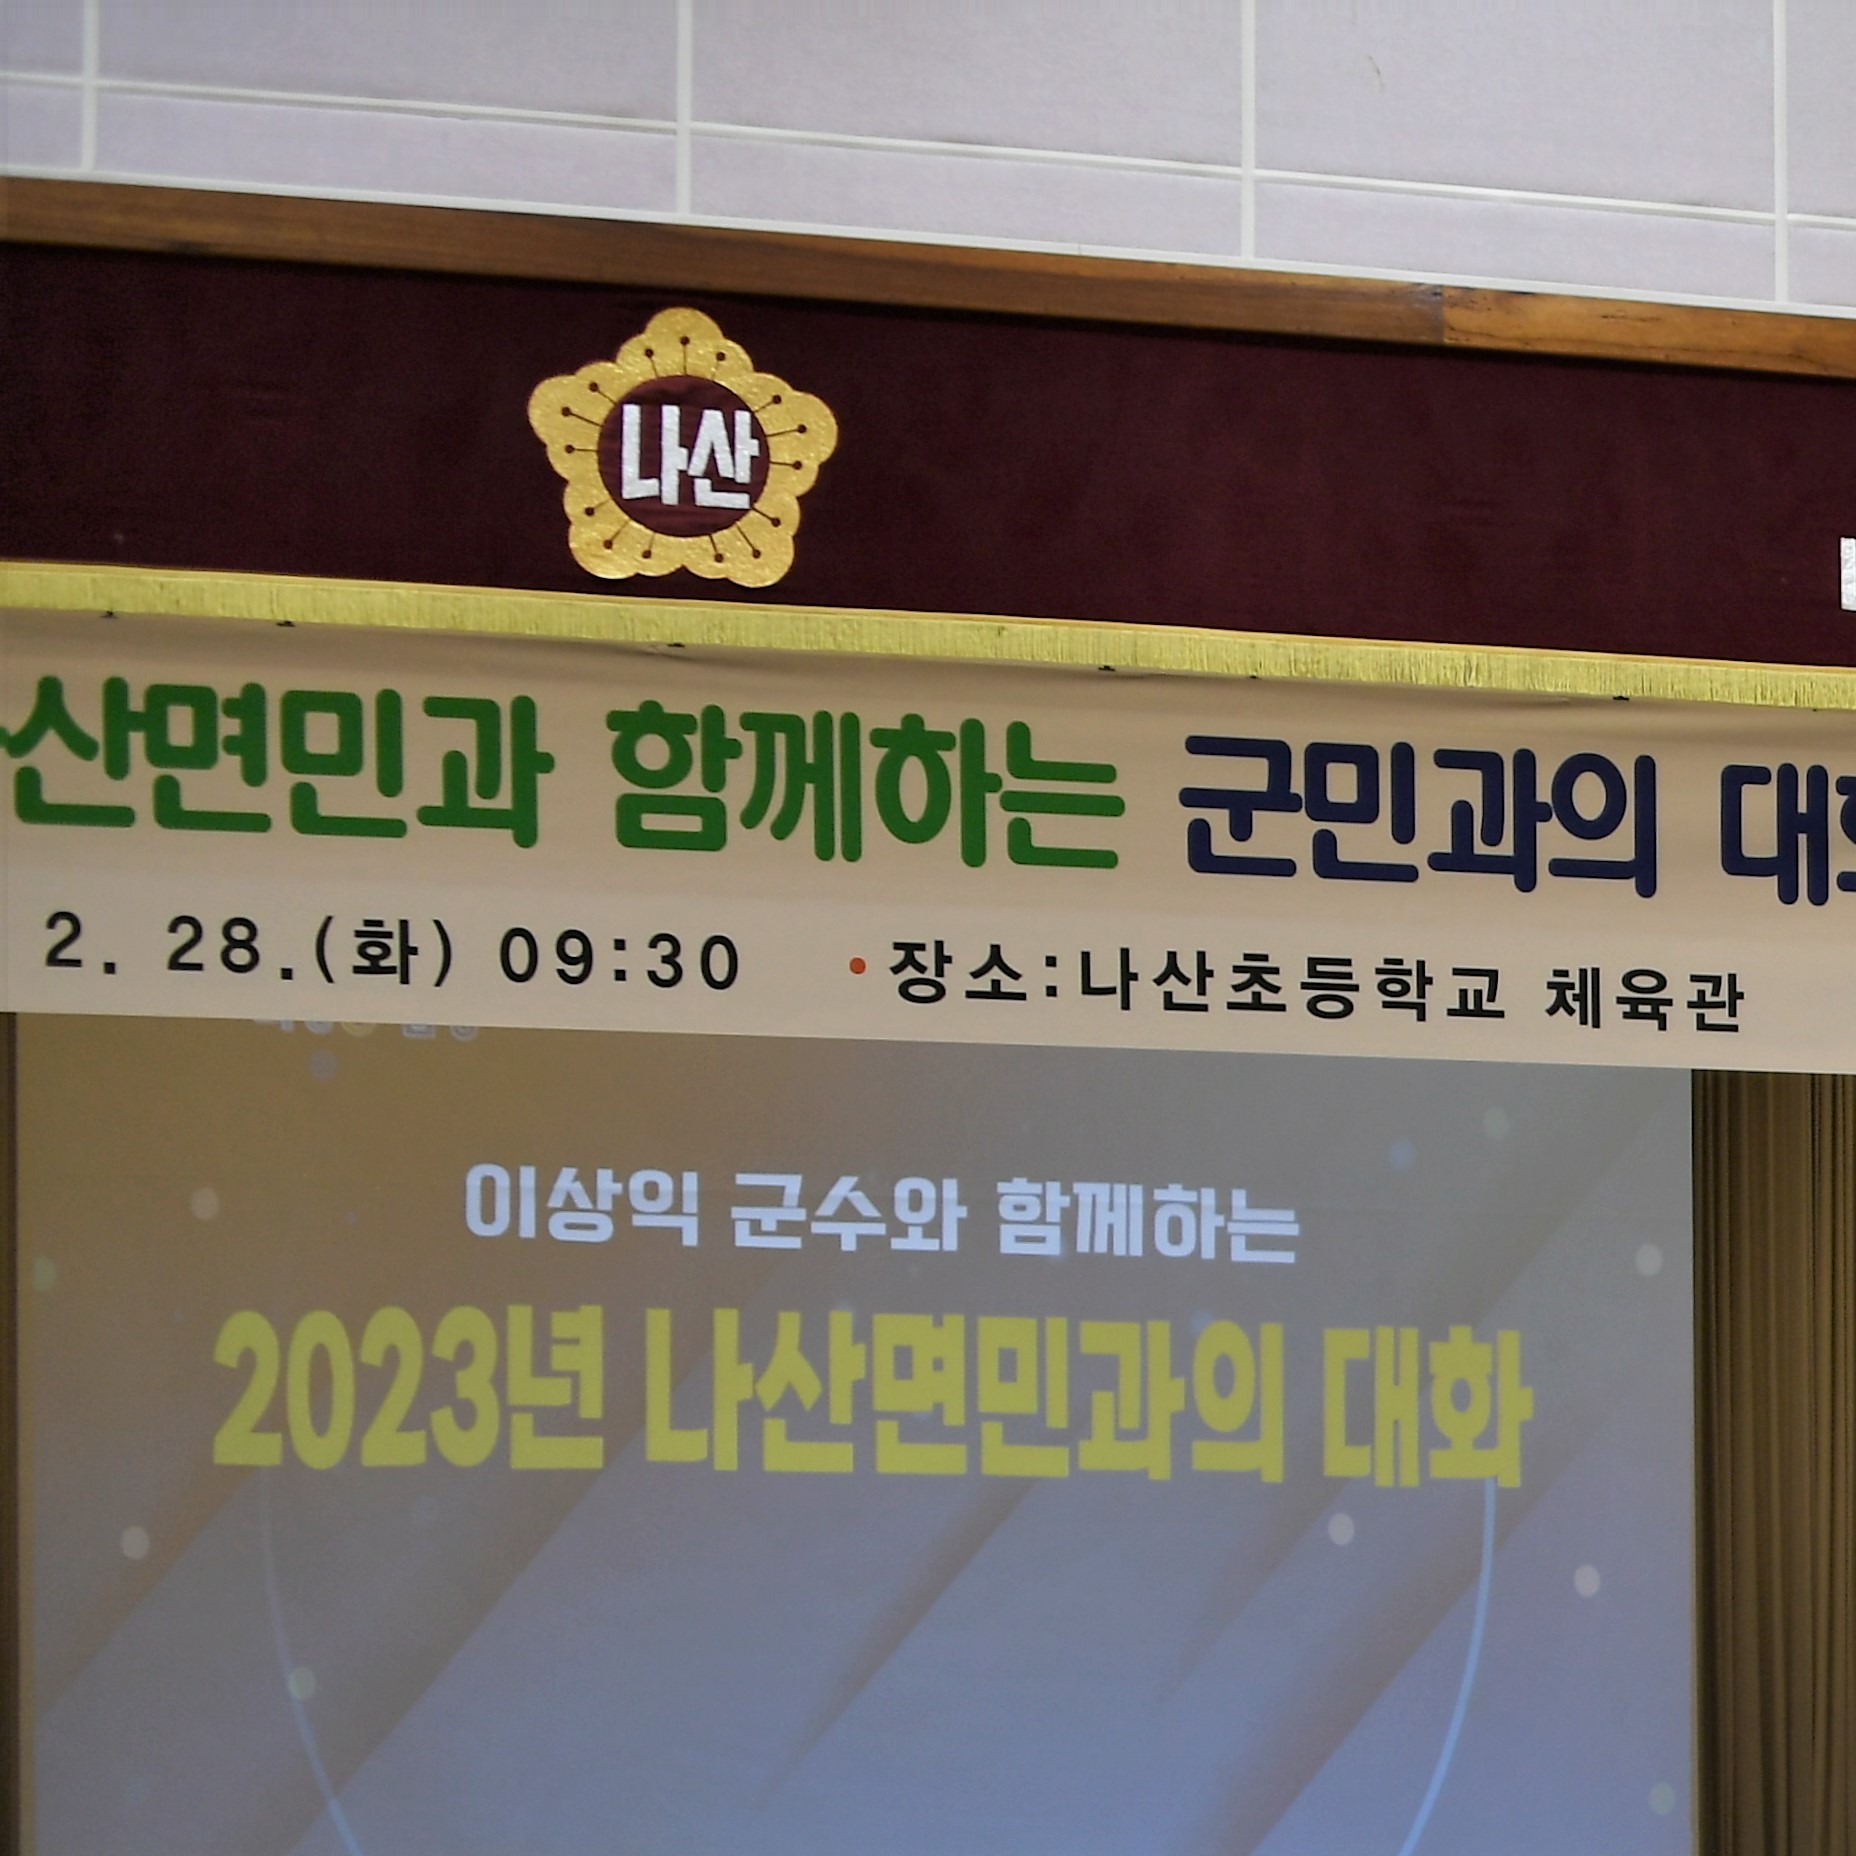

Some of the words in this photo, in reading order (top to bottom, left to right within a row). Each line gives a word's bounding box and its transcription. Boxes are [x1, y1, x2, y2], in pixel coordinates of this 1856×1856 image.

[621, 404, 759, 509] 나산
[4, 677, 554, 848] 산면민과
[606, 701, 1126, 869] 함께하는
[1178, 735, 1657, 899] 군민과의
[499, 927, 739, 991] 09:30
[1545, 966, 1745, 1033] 체육관
[465, 1163, 700, 1247] 이상익
[730, 1173, 968, 1252] 군수와
[995, 1177, 1300, 1264] 함께하는
[213, 1304, 604, 1470] 2023년
[645, 1308, 1285, 1482] 나산면민과의
[1324, 1326, 1533, 1487] 대화
